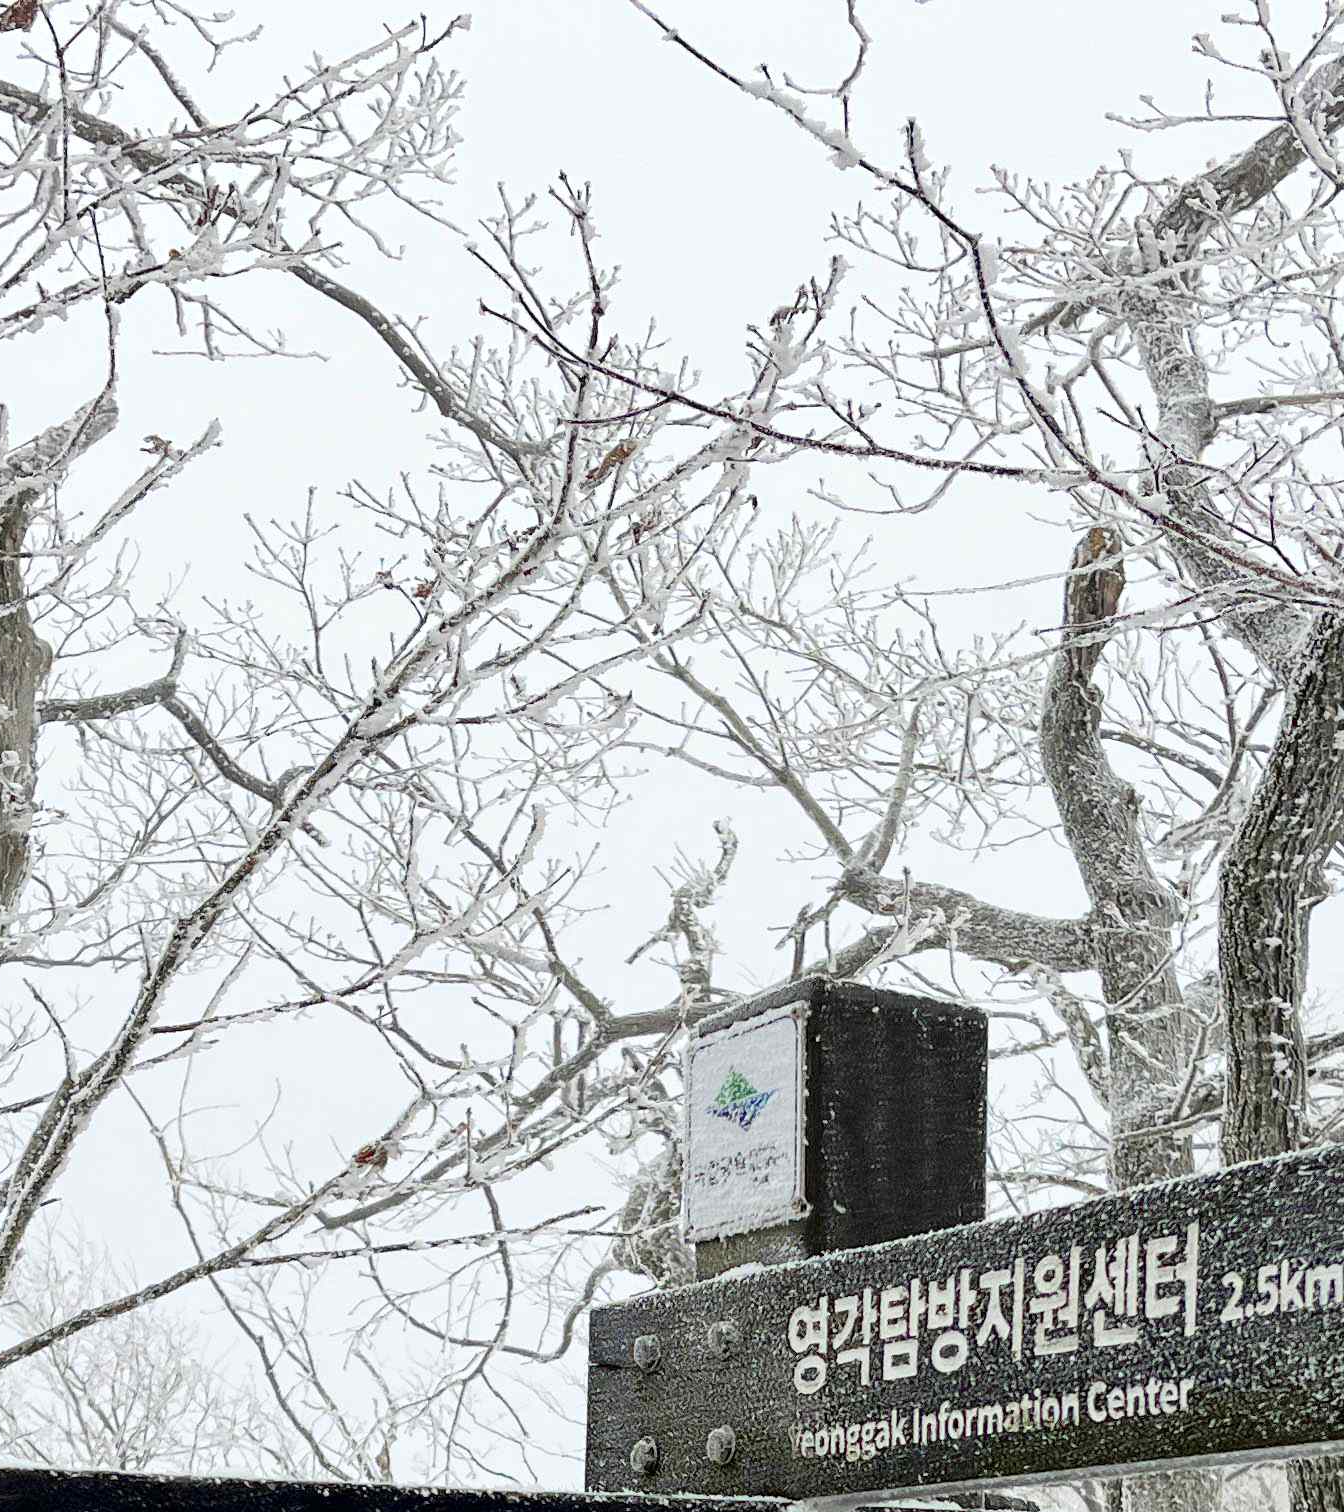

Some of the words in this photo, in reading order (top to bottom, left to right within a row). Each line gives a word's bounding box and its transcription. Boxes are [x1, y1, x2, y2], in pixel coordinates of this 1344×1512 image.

[788, 1222, 1200, 1395] 영각탐방지원센터
[912, 1385, 1080, 1446] Information
[1087, 1376, 1196, 1425] Center
